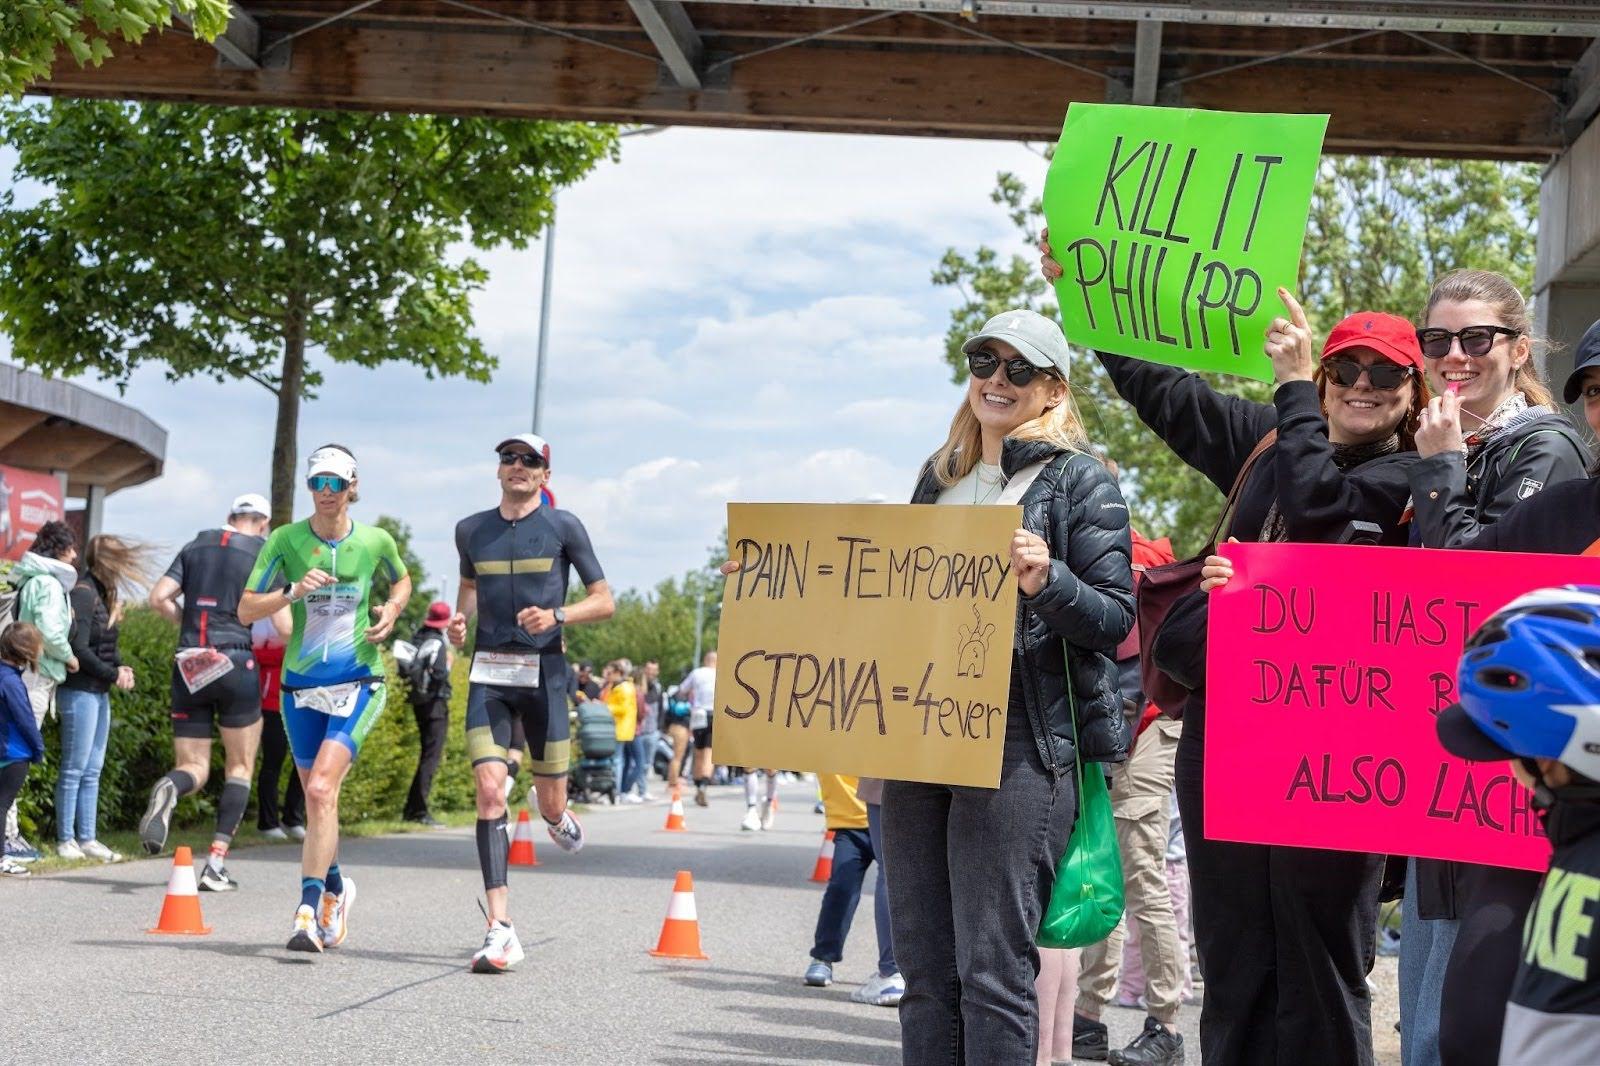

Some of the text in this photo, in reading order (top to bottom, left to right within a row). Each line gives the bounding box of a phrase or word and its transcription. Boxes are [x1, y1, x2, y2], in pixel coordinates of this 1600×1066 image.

[1094, 136, 1283, 252] KILL IT
[1067, 238, 1262, 355] PHILIPP
[735, 538, 810, 601] PAIN
[837, 536, 1012, 602] TEMPORARY
[1251, 584, 1480, 650] DU HAST
[724, 650, 887, 736] STRAVA
[912, 662, 1003, 740] 4ever
[1251, 660, 1396, 712] DAFÜR
[1285, 753, 1407, 807] ALSO
